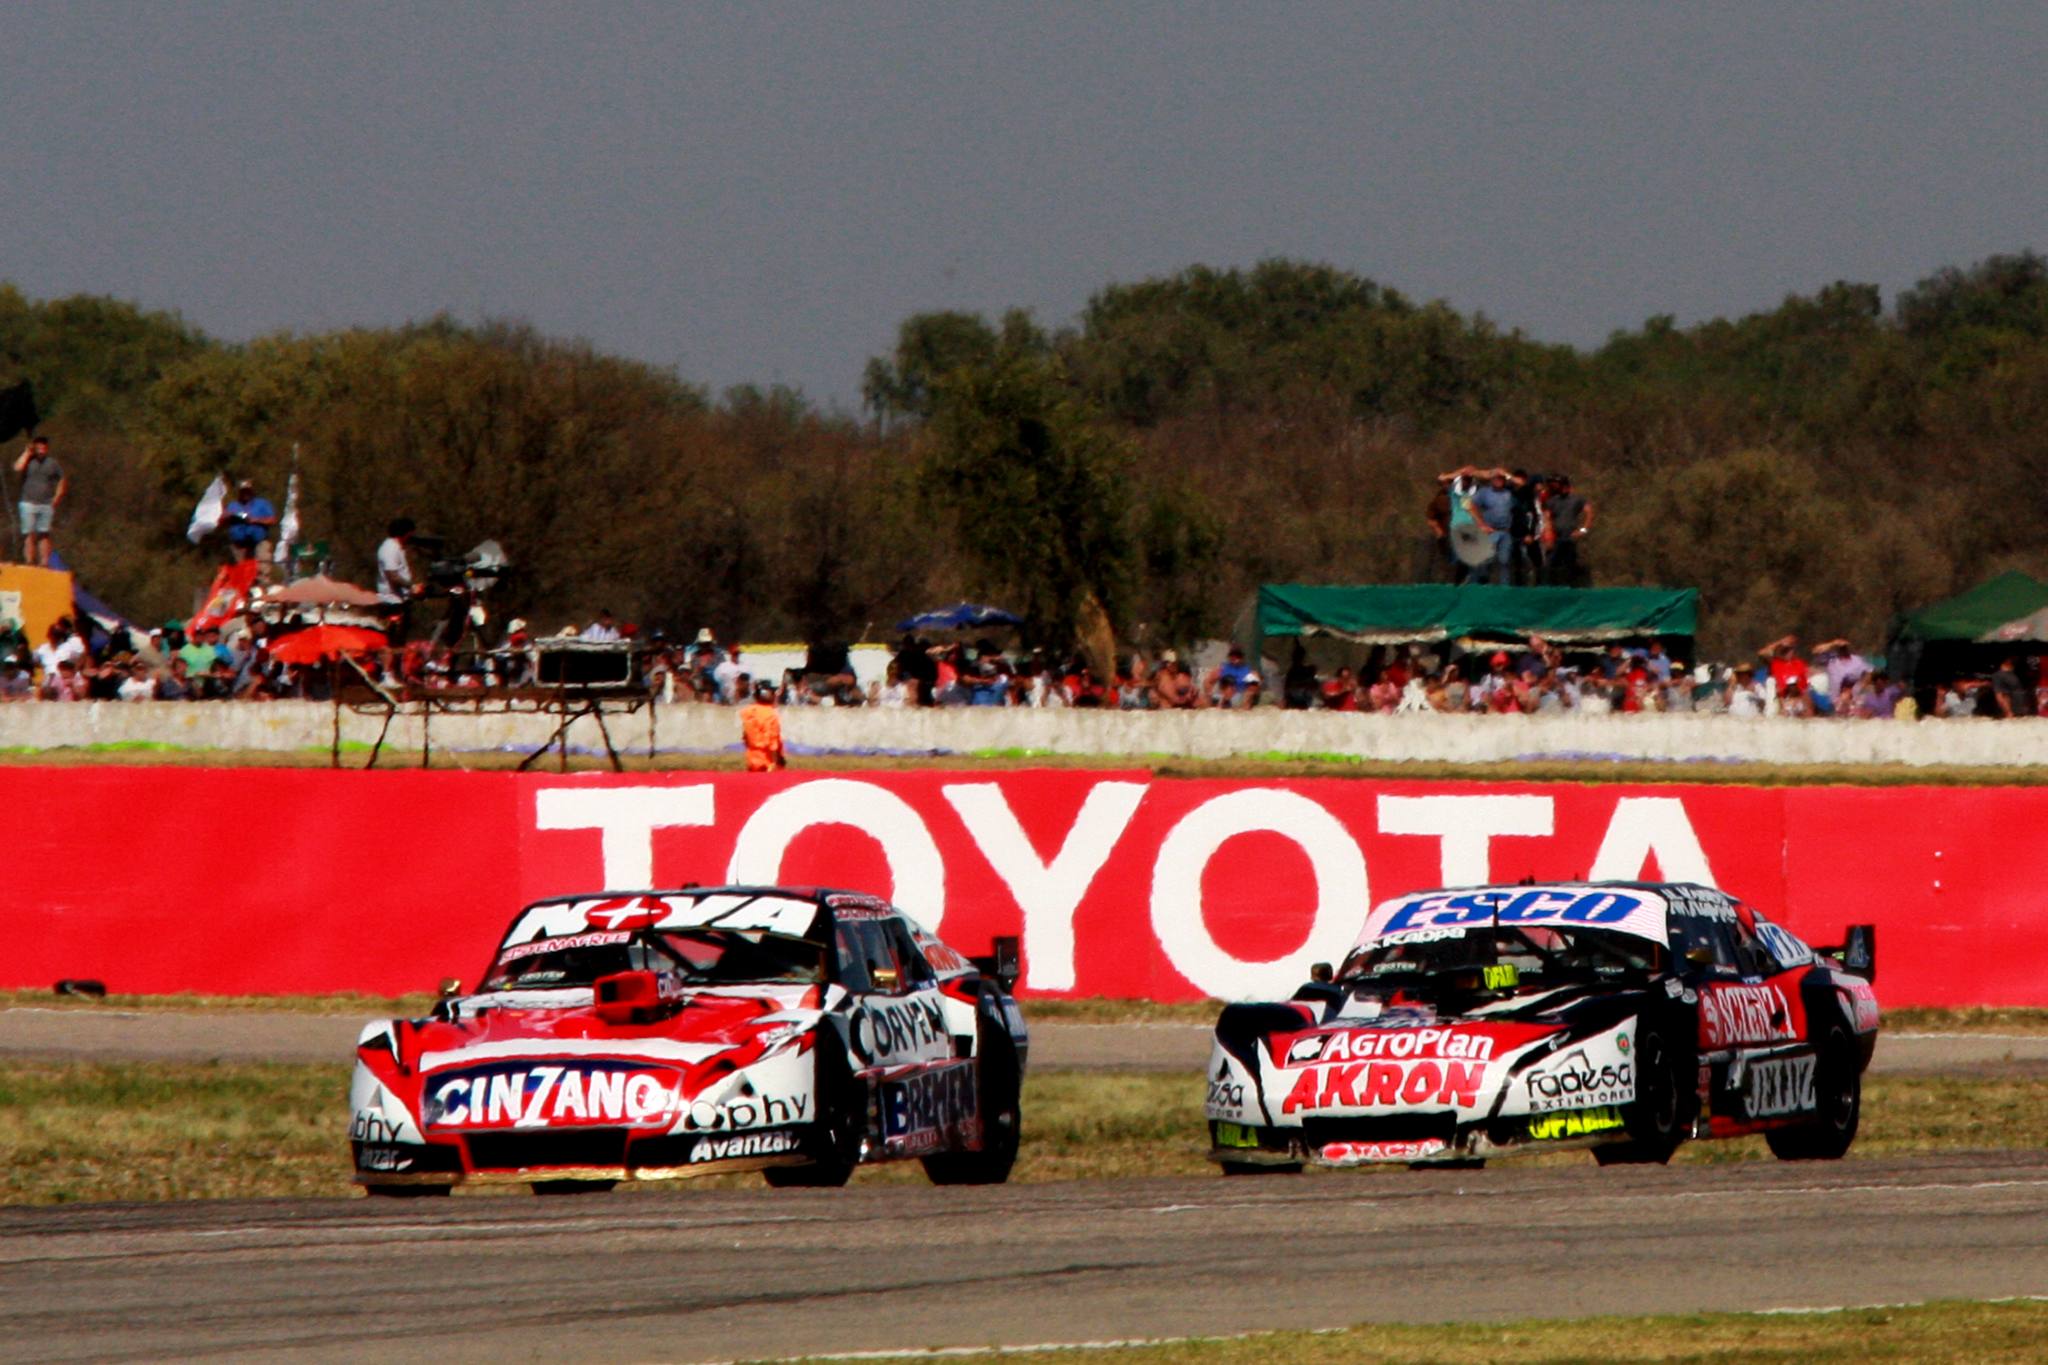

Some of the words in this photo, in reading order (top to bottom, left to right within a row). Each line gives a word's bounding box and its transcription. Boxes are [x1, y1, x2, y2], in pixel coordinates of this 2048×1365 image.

[1381, 888, 1642, 934] ESCO
[849, 997, 949, 1067] CORVEN
[1321, 1028, 1495, 1062] AgroPlan
[433, 1066, 680, 1128] CINZANO
[1281, 1061, 1488, 1115] AKRON
